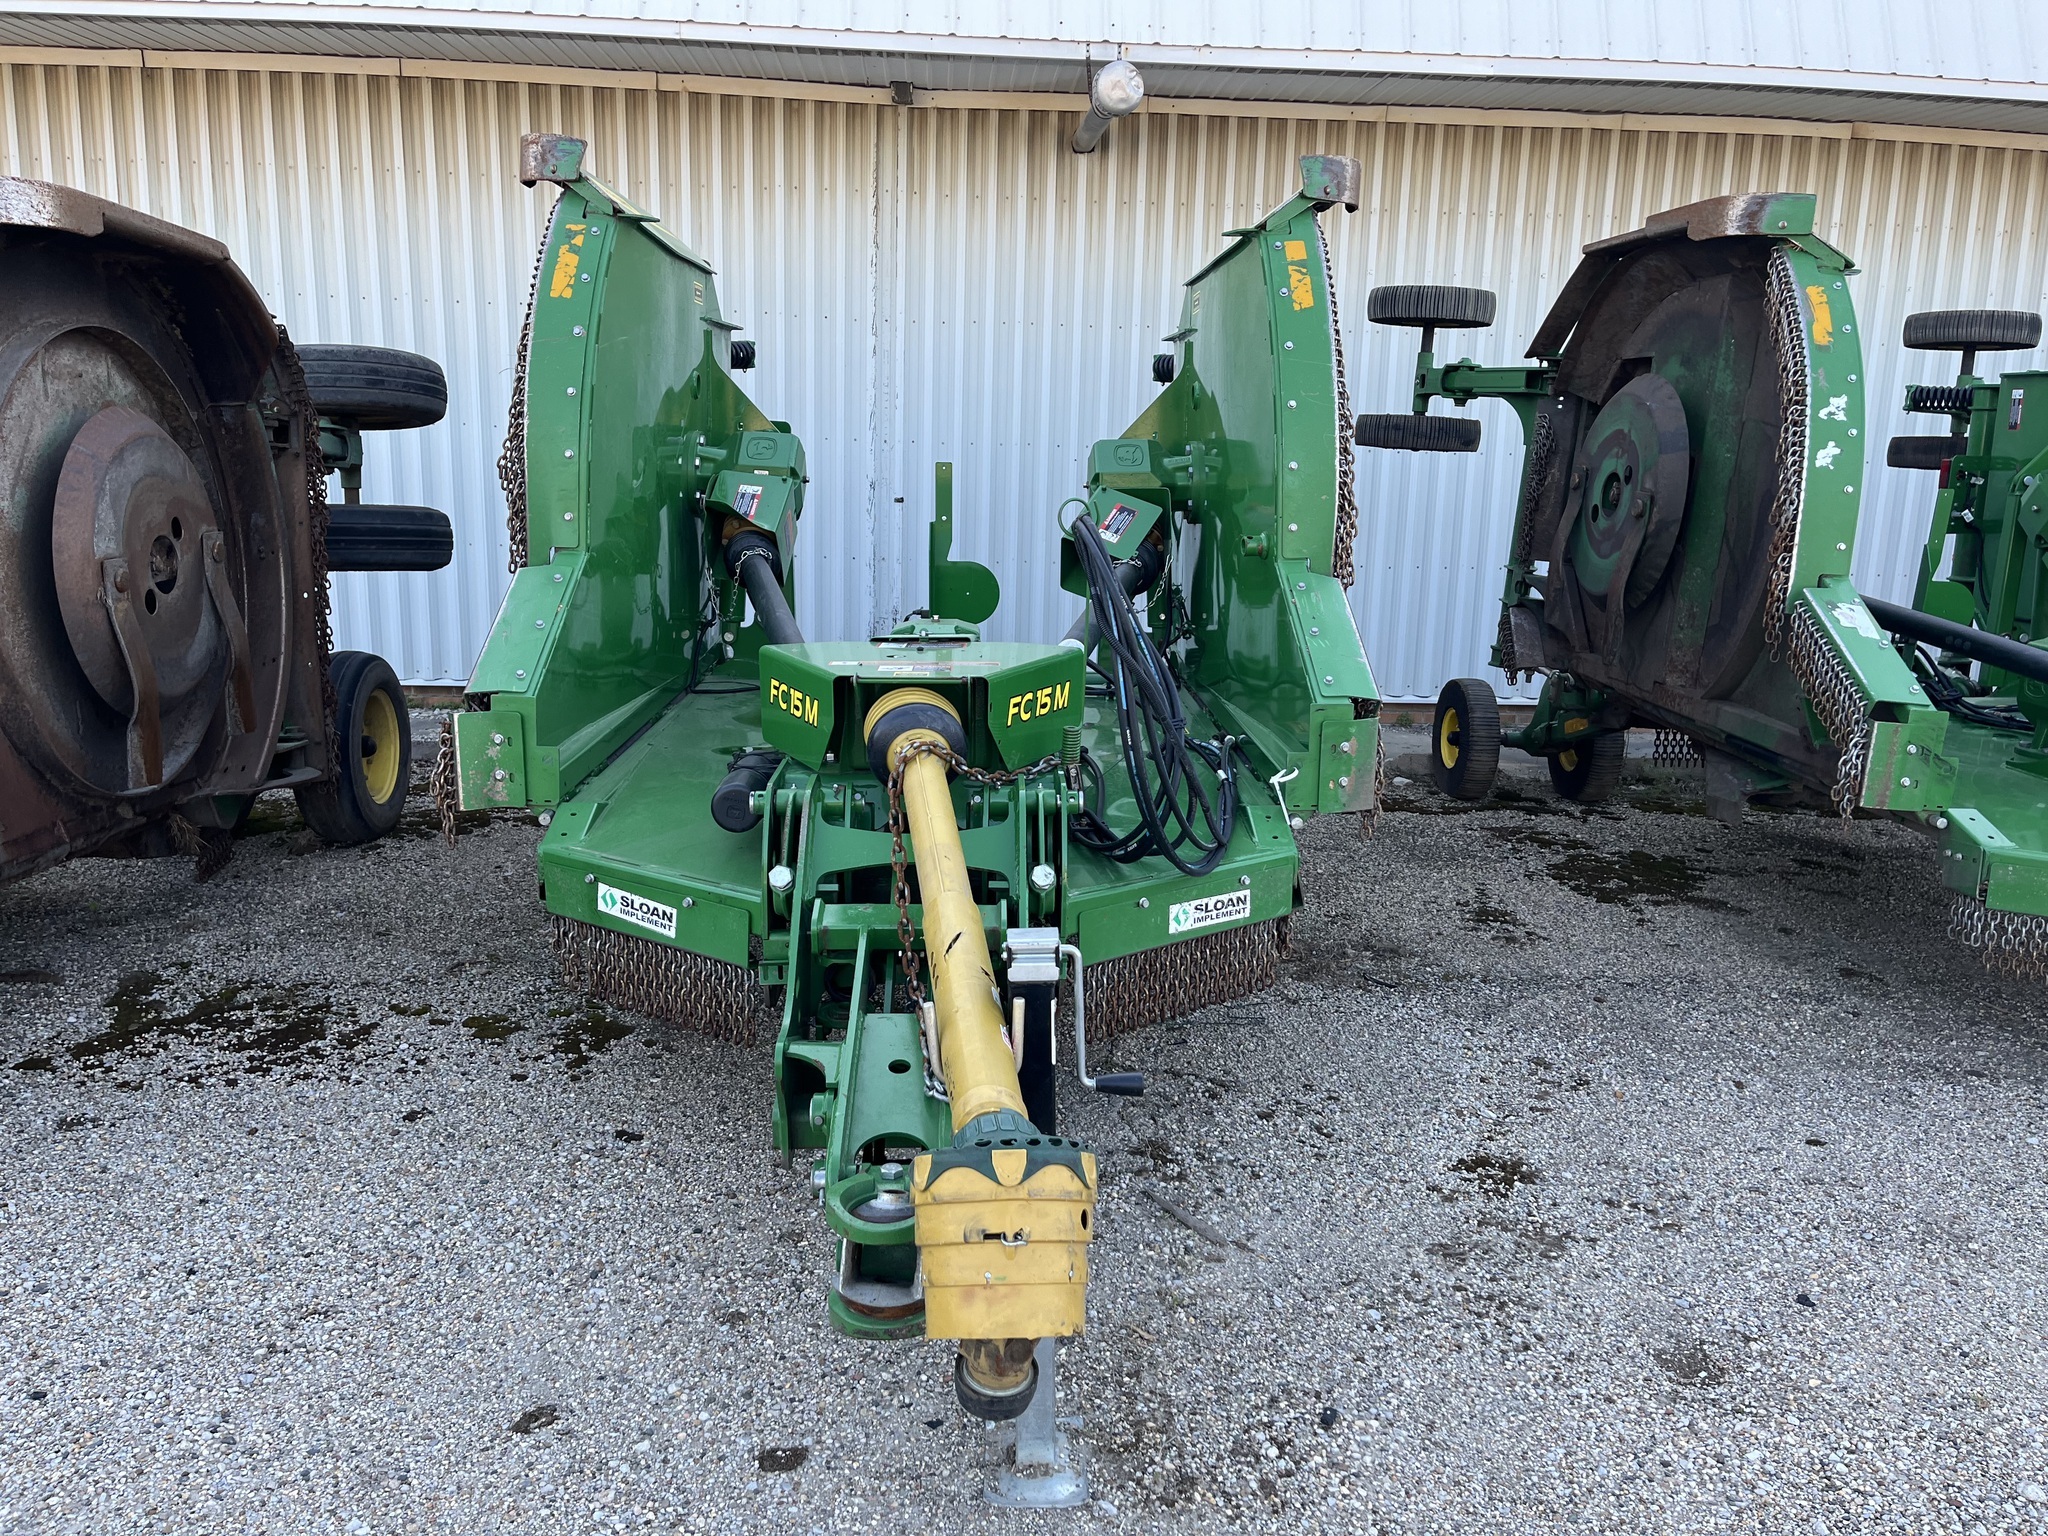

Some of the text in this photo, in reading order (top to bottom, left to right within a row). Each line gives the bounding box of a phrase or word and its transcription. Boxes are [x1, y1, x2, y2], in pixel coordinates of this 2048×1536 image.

[769, 678, 820, 728] FC15M
[1006, 681, 1071, 729] FC15M
[620, 895, 674, 924] SLOAN
[1193, 895, 1248, 915] SLOAN
[1193, 906, 1248, 924] IMPLEMENT
[619, 907, 673, 932] IMPLEMENT
